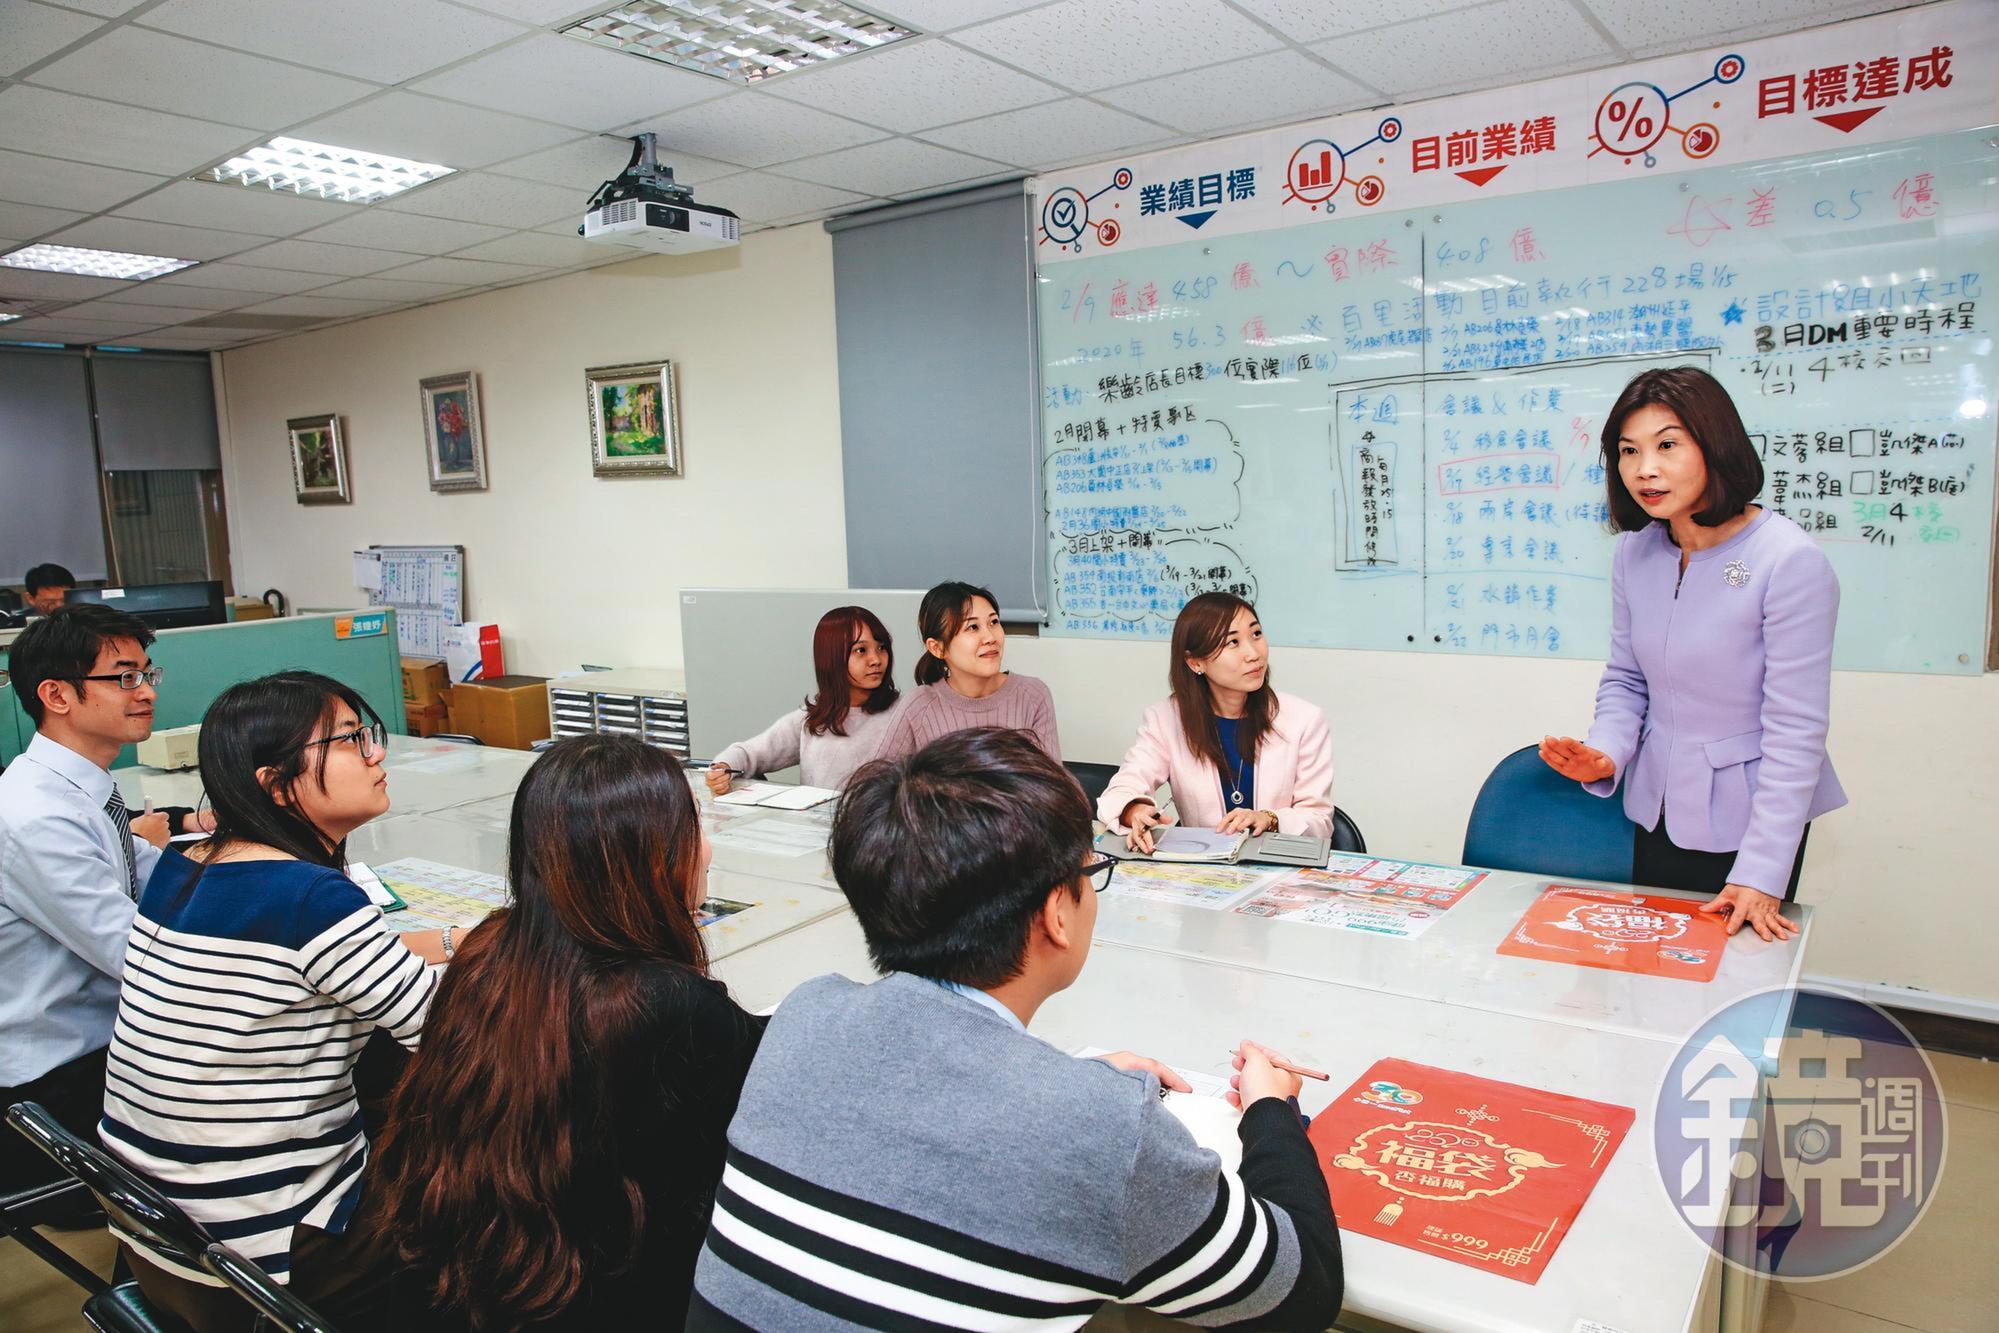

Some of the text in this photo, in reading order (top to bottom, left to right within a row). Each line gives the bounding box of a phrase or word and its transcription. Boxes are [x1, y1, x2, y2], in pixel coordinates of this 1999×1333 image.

[1758, 45, 1954, 119] 目標達成
[1412, 116, 1556, 172] 目前業績
[1140, 166, 1256, 216] 業績目標
[1376, 1139, 1497, 1182] 福袋
